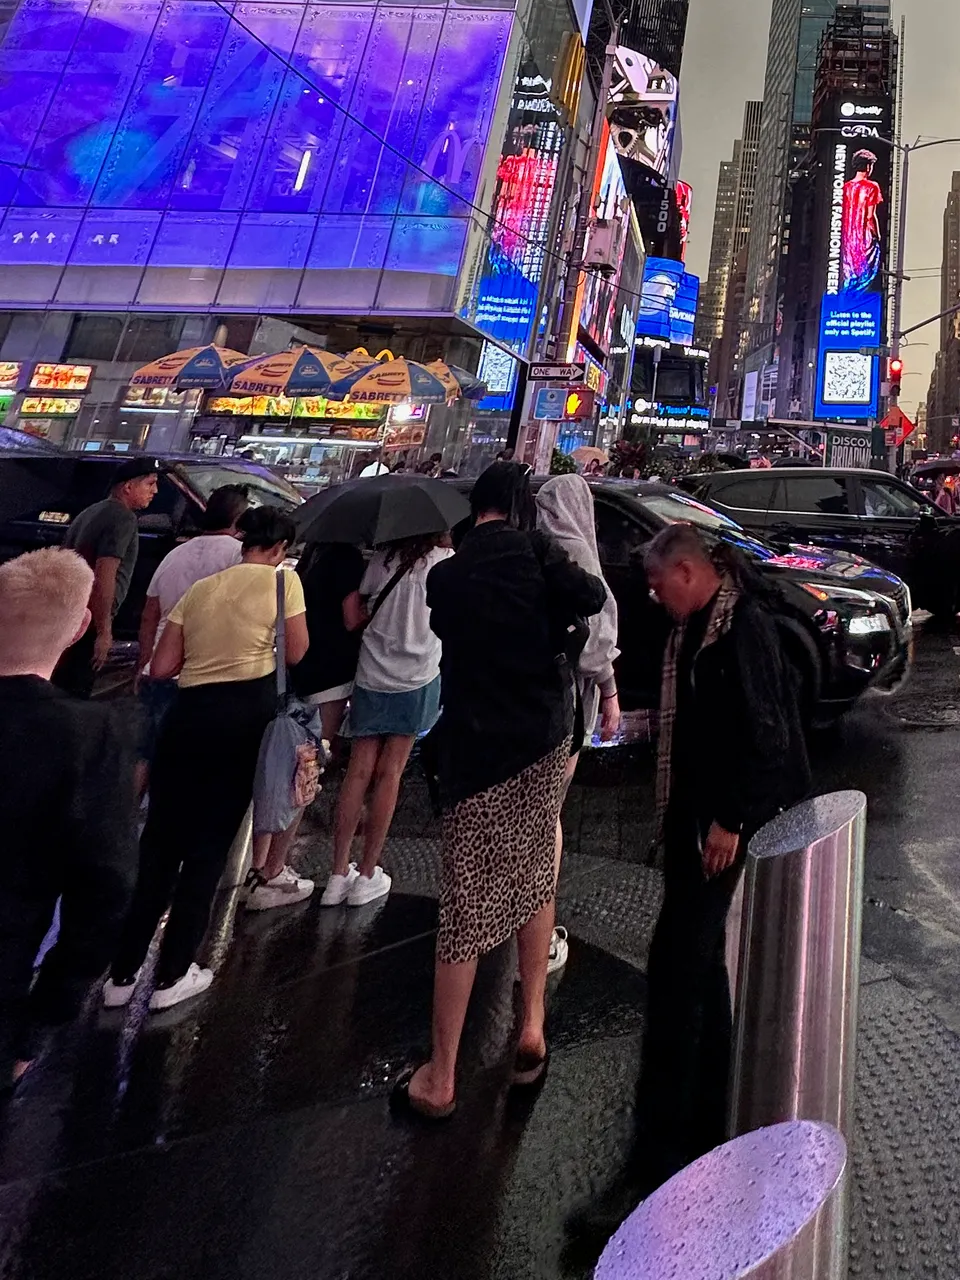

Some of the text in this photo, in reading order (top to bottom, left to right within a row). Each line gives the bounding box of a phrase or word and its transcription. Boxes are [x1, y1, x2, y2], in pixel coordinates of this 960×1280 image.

[855, 105, 883, 116] Spotify
[657, 189, 670, 233] 1500
[826, 144, 847, 296] NEW YORK FASHION WEEK
[851, 328, 876, 337] Spotify
[533, 367, 578, 376] ONE WAY
[132, 375, 174, 385] SABRETT
[232, 380, 282, 394] SABRETT
[352, 391, 406, 401] SABRETT
[832, 435, 872, 445] DISCOV
[831, 446, 872, 468] BROADW
